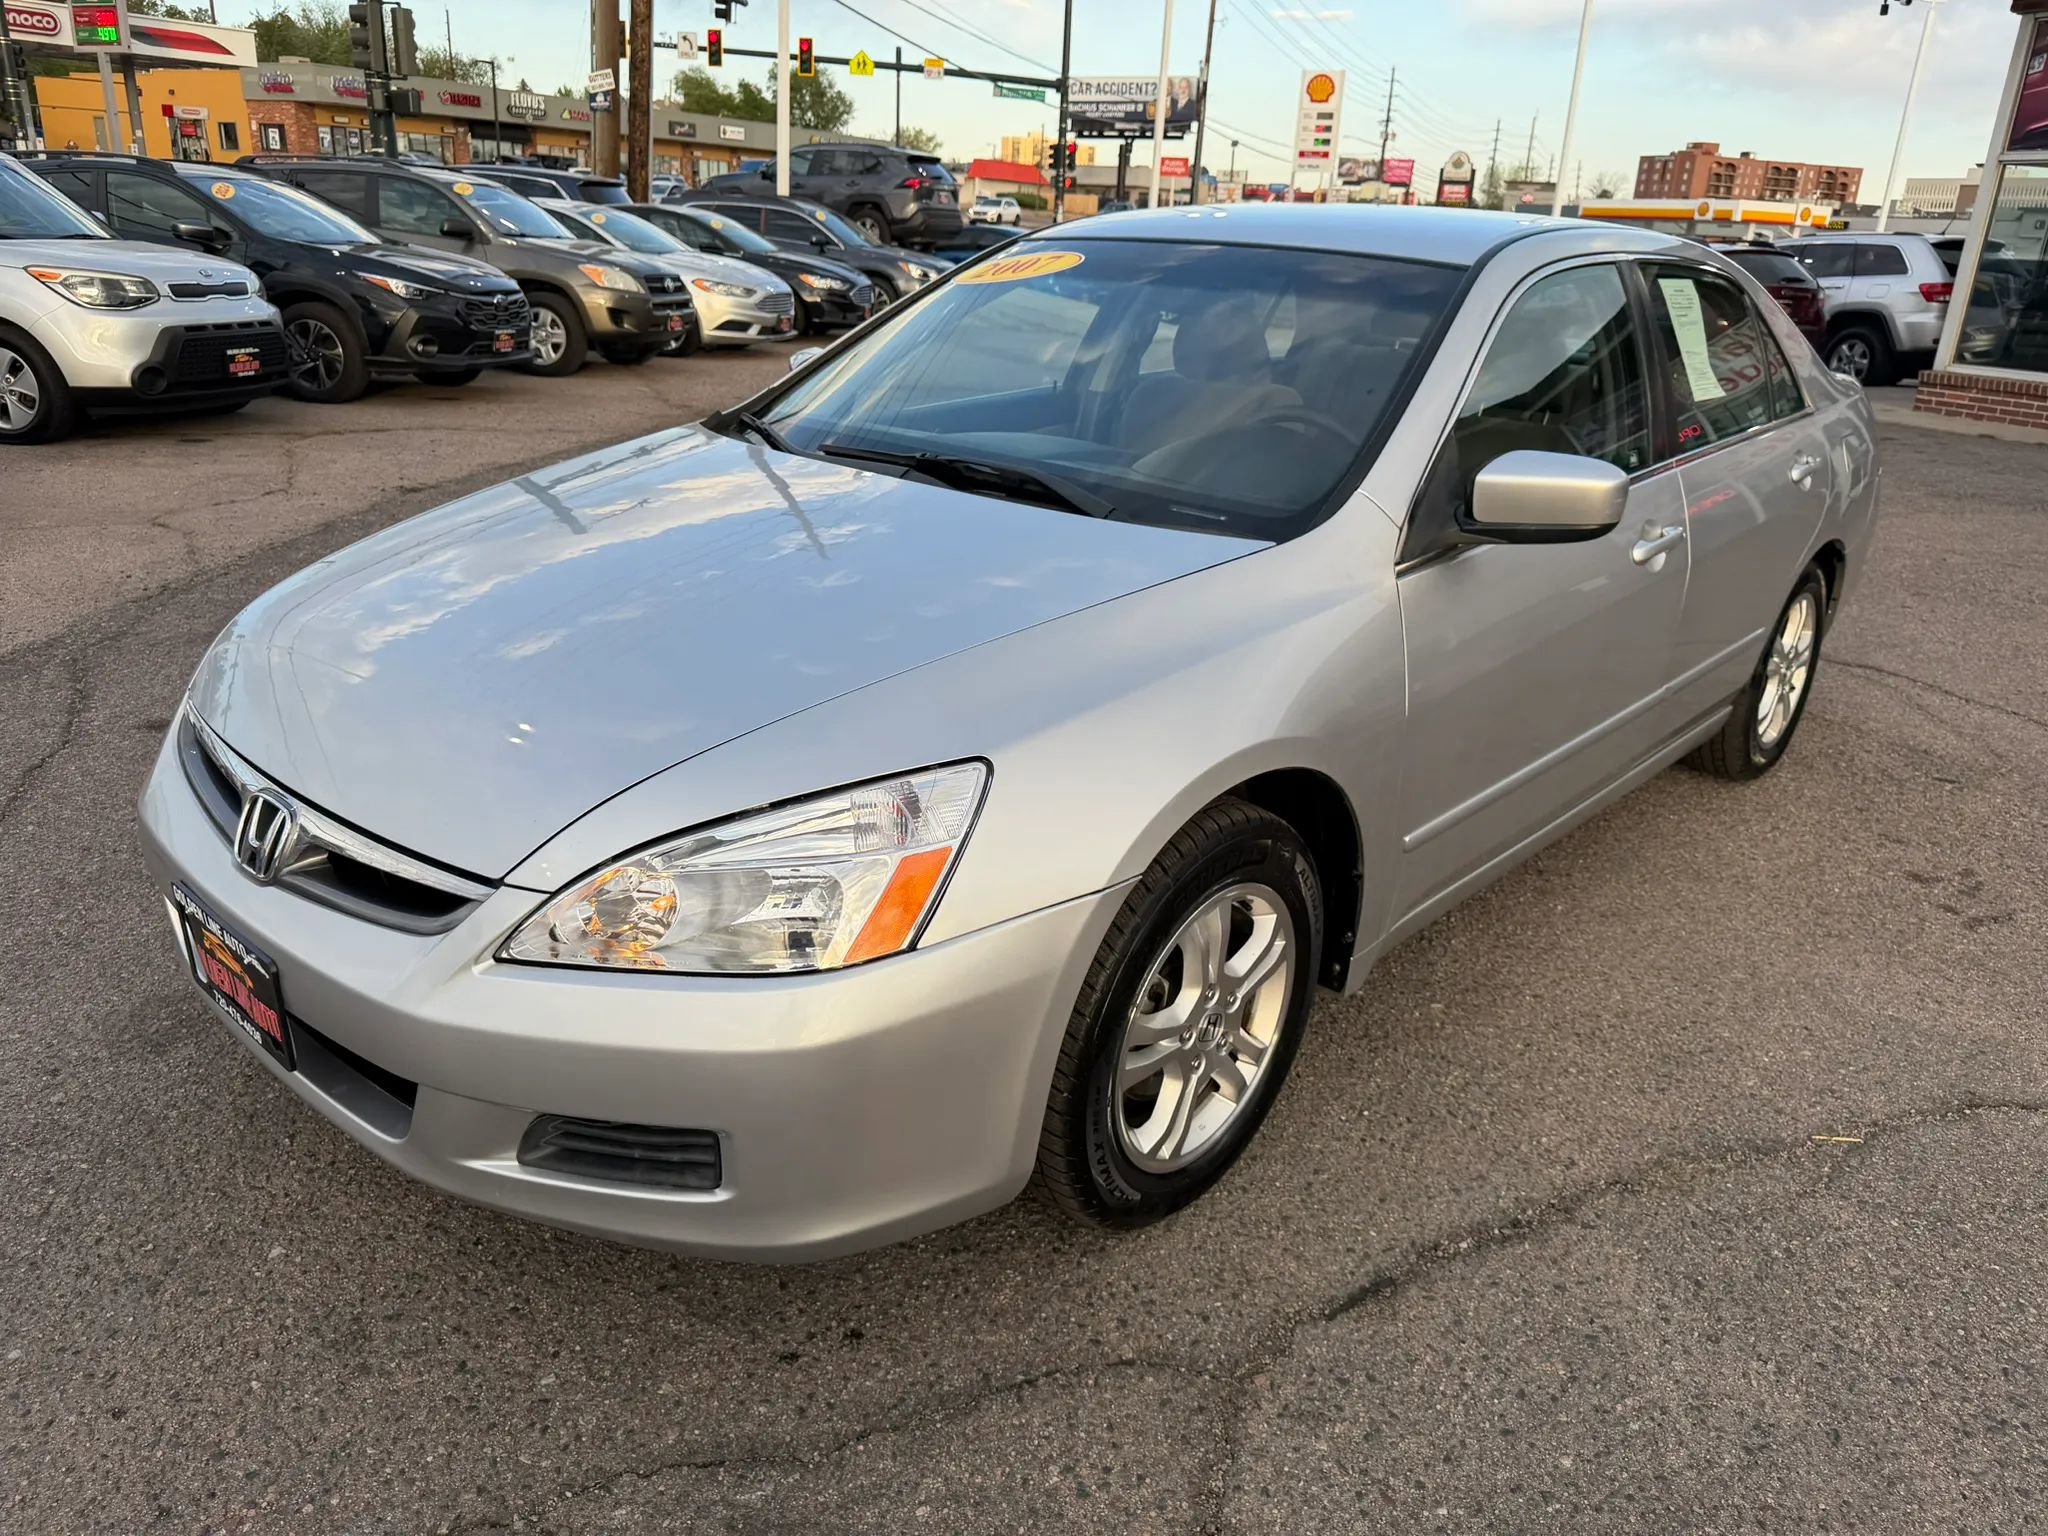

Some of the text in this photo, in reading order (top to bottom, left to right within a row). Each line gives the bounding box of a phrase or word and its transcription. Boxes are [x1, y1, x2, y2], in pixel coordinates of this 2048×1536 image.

[6, 11, 55, 29] noco
[1070, 82, 1158, 97] CAR ACCIDENT?
[970, 254, 1065, 280] 2007
